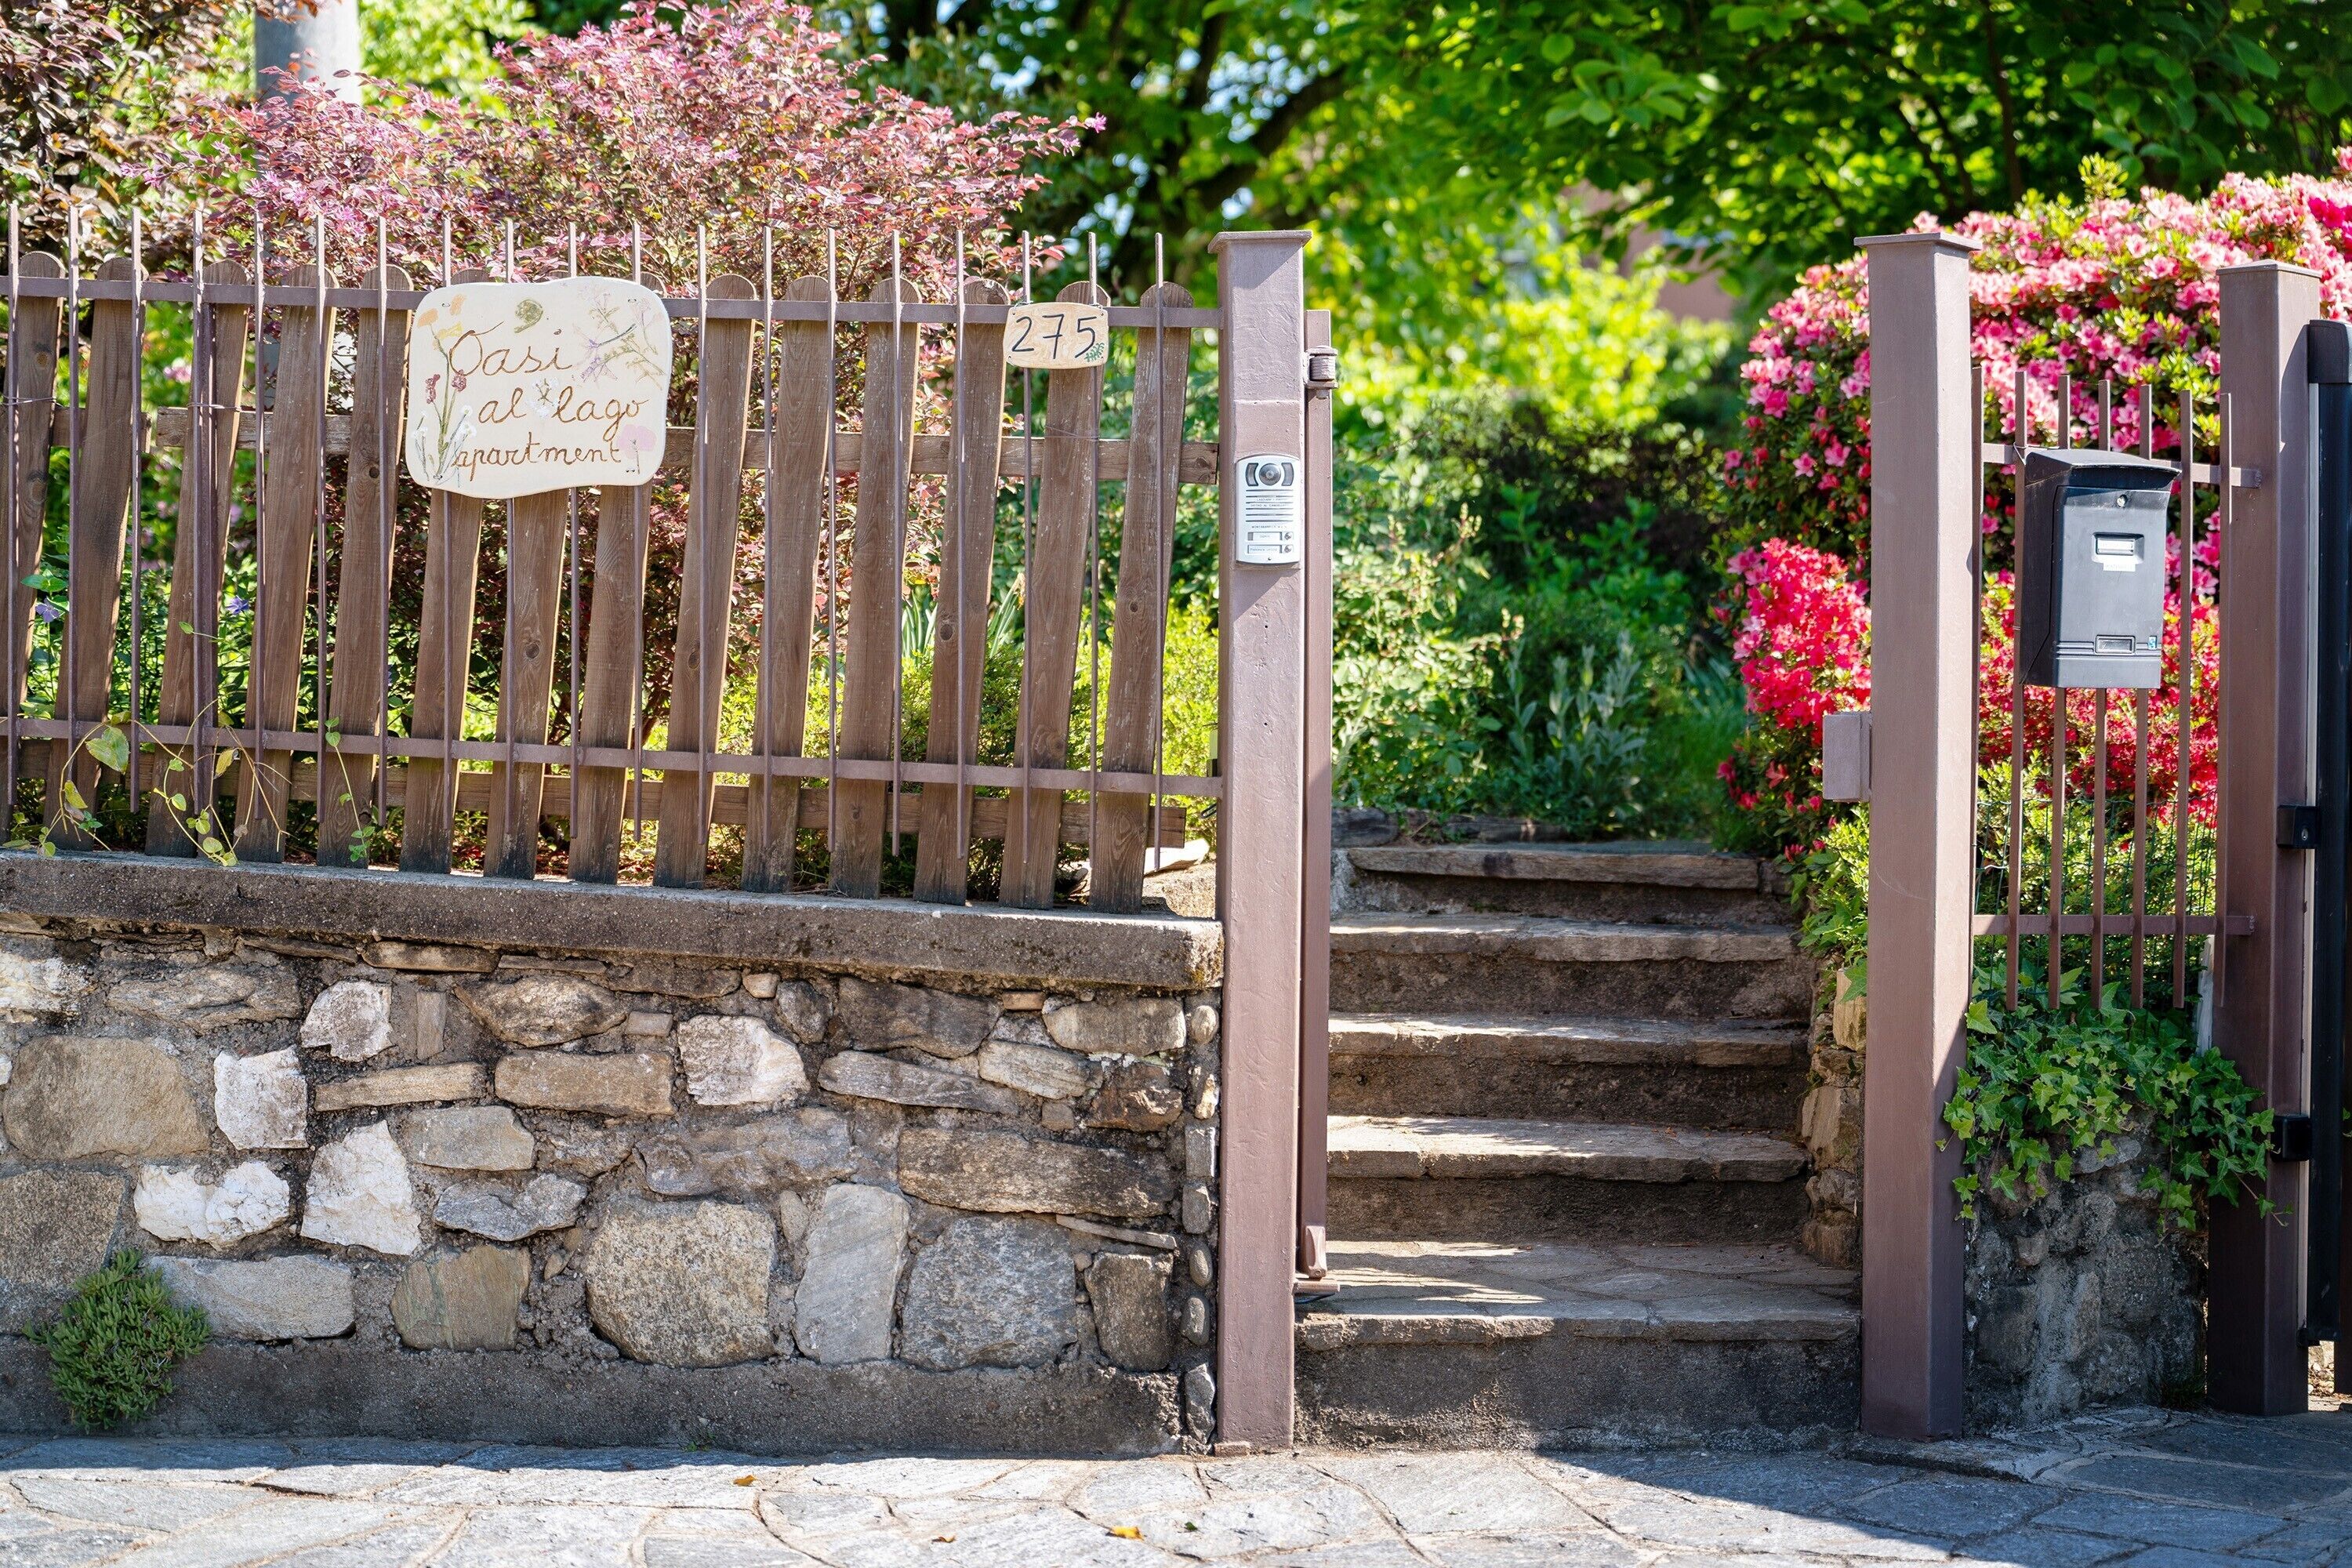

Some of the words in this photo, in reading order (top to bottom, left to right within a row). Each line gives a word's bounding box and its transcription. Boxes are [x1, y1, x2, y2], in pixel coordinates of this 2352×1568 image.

[448, 321, 573, 376] Oasi
[1011, 314, 1098, 360] 275
[477, 387, 527, 424] al
[550, 386, 651, 442] lago
[451, 431, 622, 481] apartment
